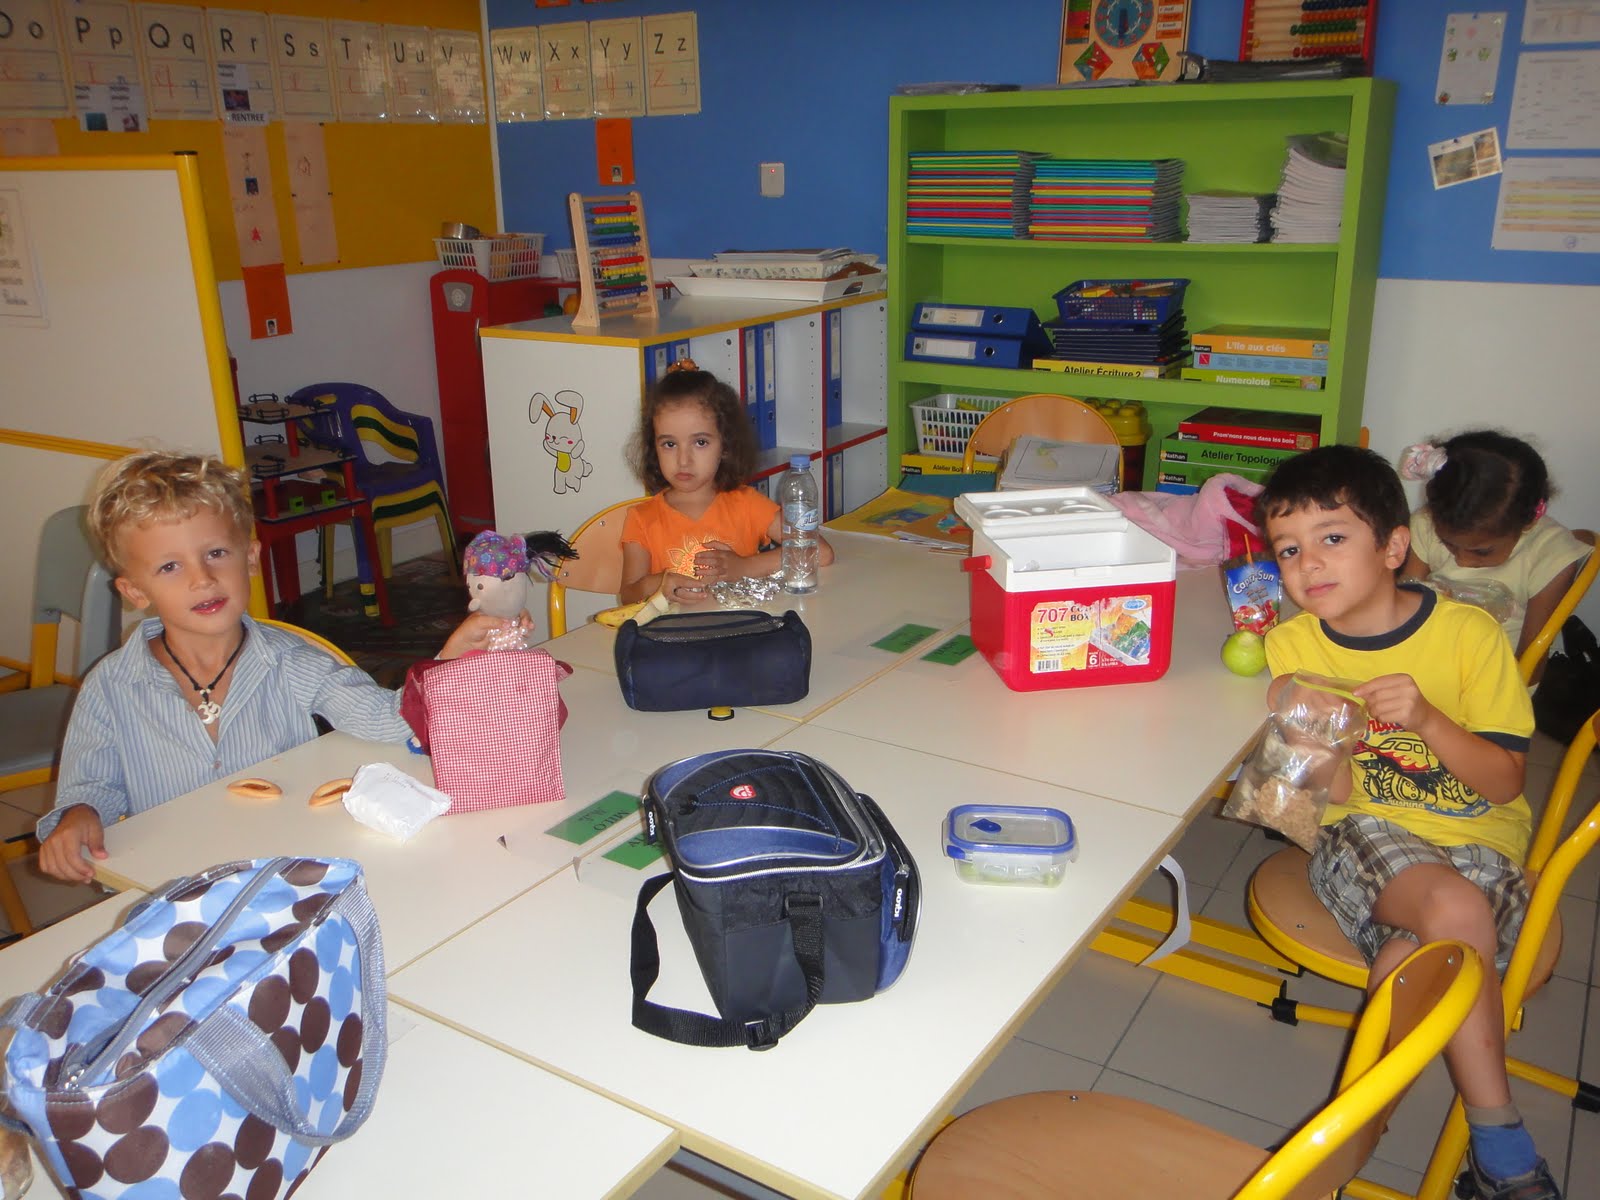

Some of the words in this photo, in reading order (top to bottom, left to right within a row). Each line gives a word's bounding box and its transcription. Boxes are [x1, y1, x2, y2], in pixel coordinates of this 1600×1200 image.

[231, 113, 265, 122] RENTREE
[1247, 344, 1264, 352] aux
[1165, 453, 1186, 461] Nathan
[1201, 450, 1233, 461] Atelier
[1236, 452, 1284, 466] Topologi
[1164, 474, 1185, 482] Nathan
[1233, 570, 1275, 594] Capri-Sun
[1037, 607, 1068, 623] 707
[1089, 654, 1098, 665] 6
[593, 810, 629, 831] MILO
